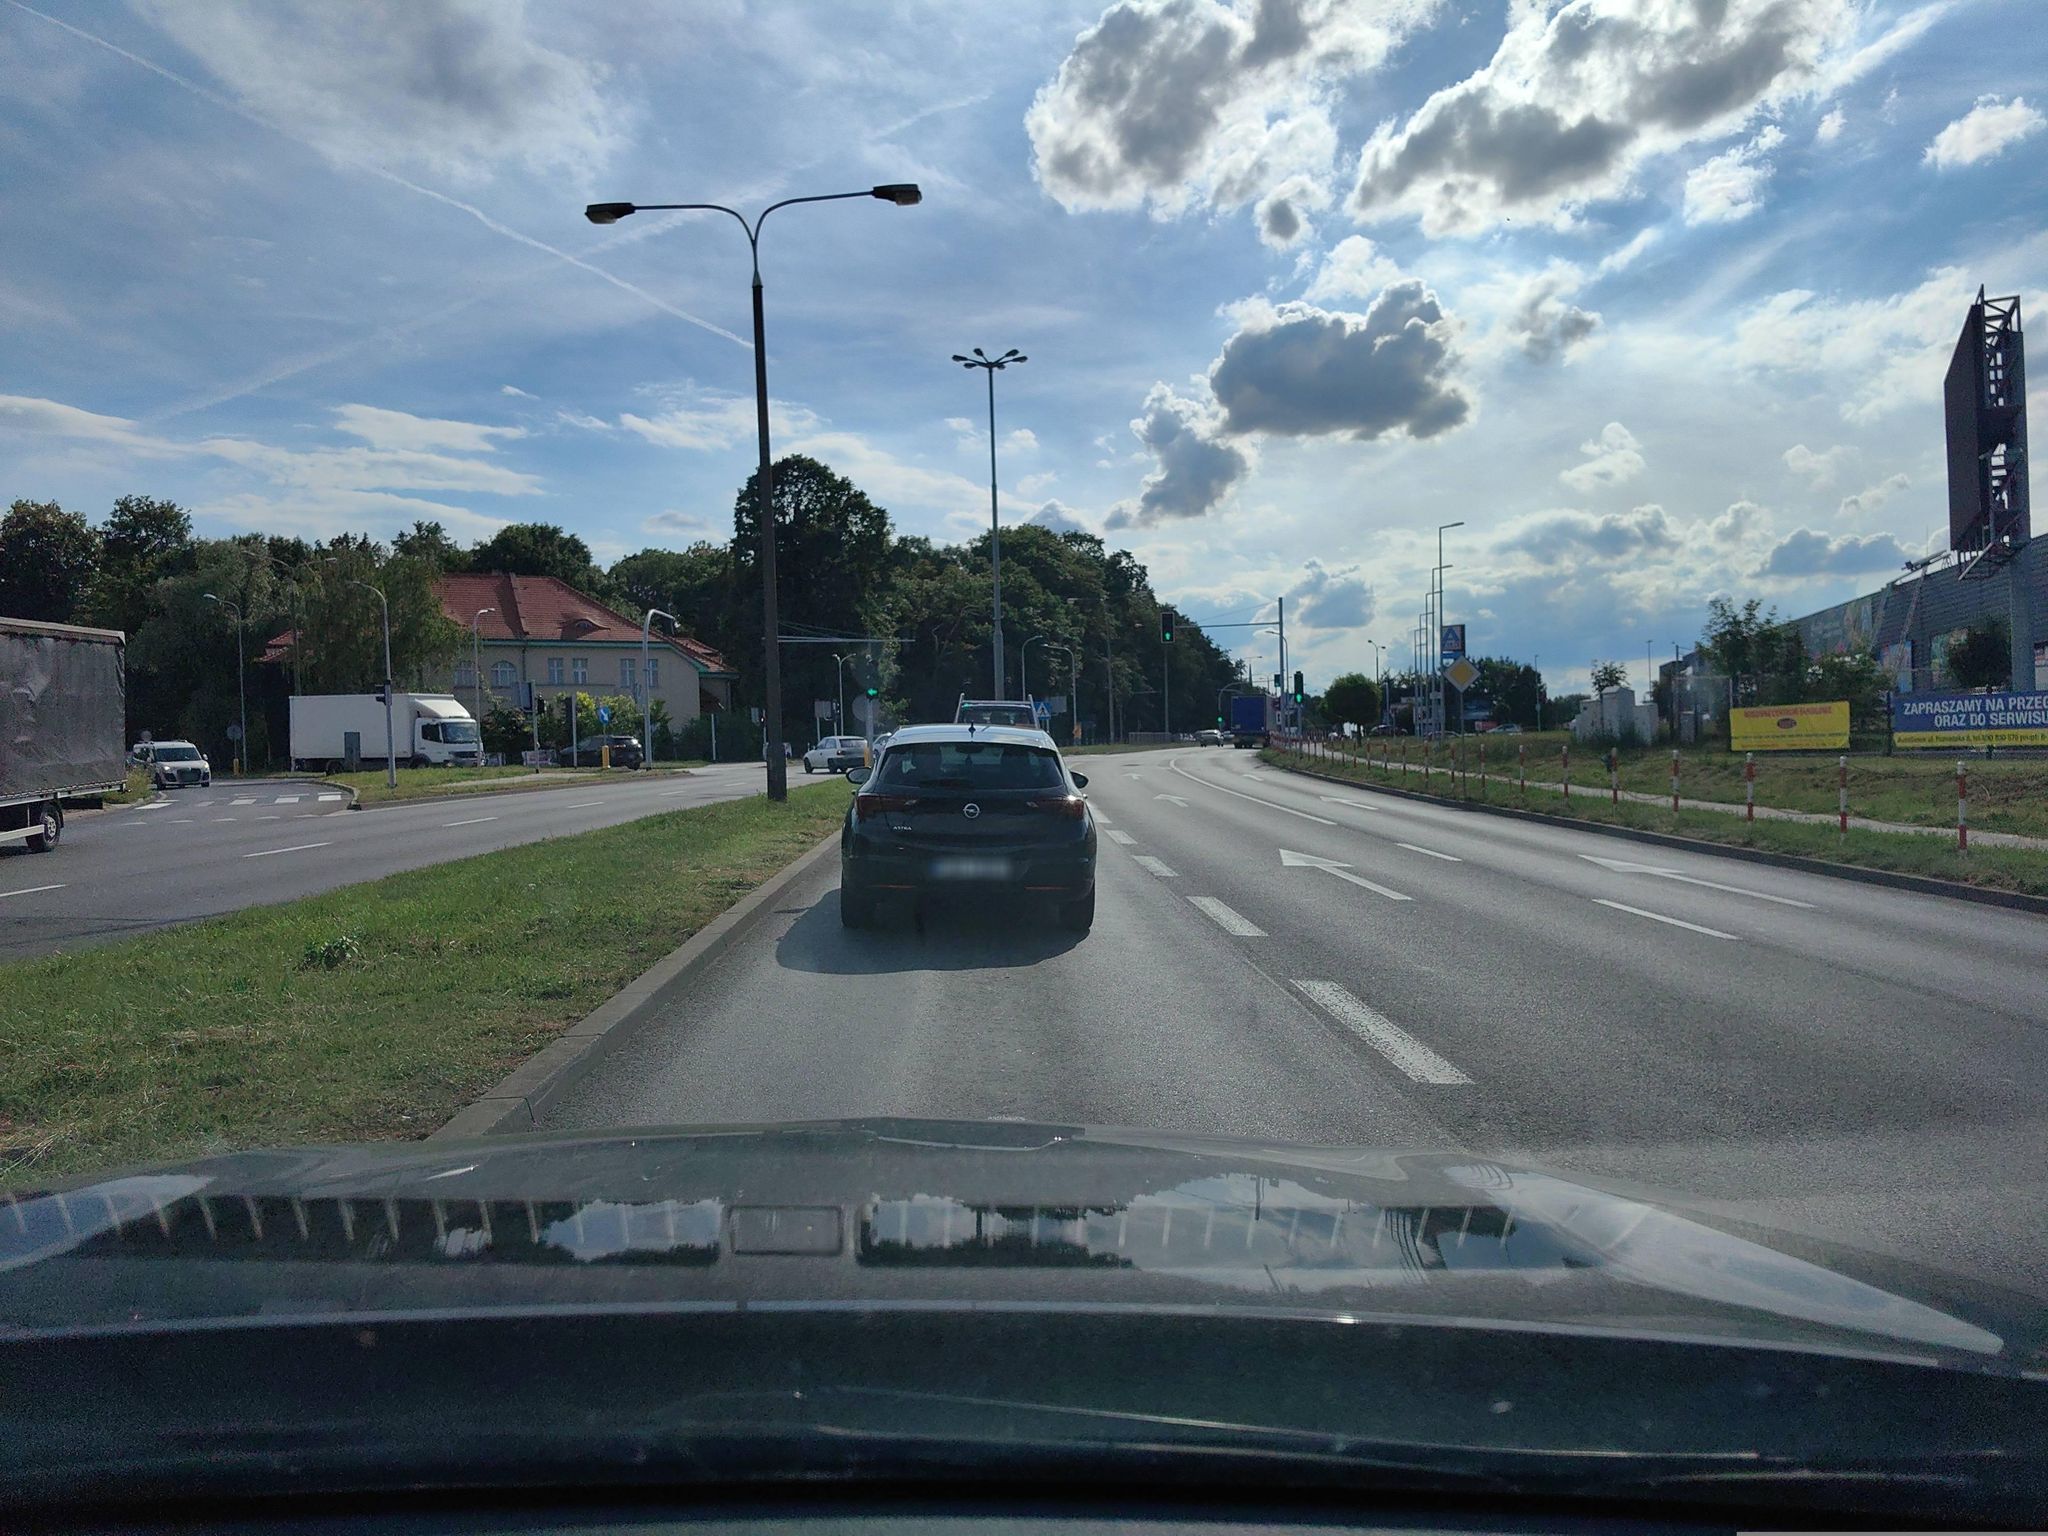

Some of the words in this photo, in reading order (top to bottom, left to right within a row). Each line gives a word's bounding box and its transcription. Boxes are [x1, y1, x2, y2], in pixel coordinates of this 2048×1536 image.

[1903, 699, 1982, 715] ZAPRASZAMY
[1985, 699, 2005, 712] NA
[1934, 713, 1966, 728] ORAZ
[1969, 712, 1986, 726] DO
[1989, 710, 2048, 726] SERWISU
